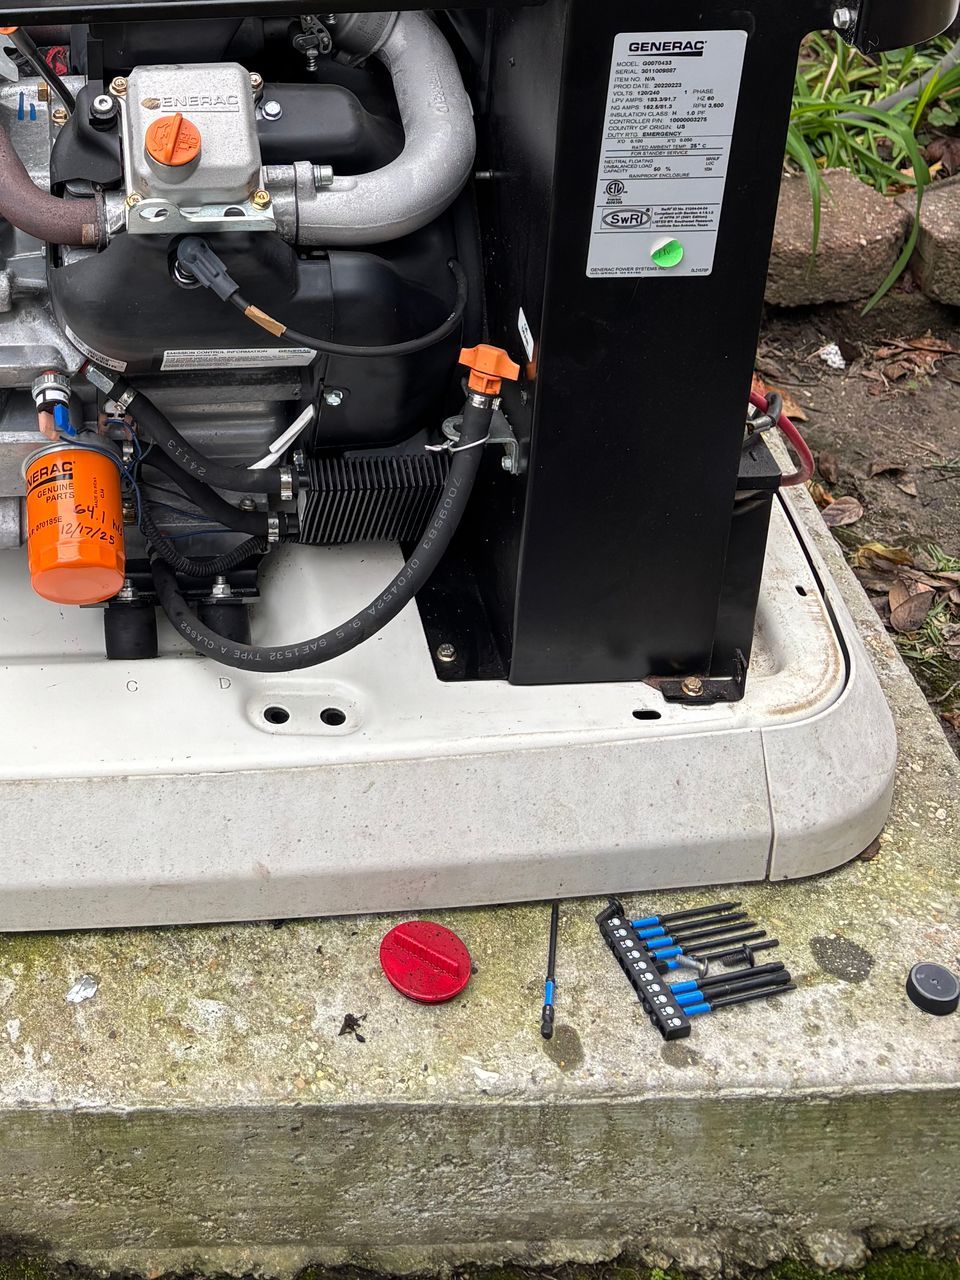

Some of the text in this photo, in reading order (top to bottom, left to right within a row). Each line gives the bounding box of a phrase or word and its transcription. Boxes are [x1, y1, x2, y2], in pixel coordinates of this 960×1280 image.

[629, 41, 705, 52] GENERAC
[610, 213, 644, 225] SwRI
[27, 461, 75, 487] NERAC
[37, 483, 75, 499] GENUINE
[46, 491, 75, 503] PARTS
[74, 504, 105, 524] 64.1
[61, 522, 115, 545] 12/17/25
[221, 646, 228, 654] A
[234, 650, 261, 661] TYPE
[270, 639, 327, 661] SAE1532
[126, 680, 138, 692] C
[219, 677, 231, 689] D
